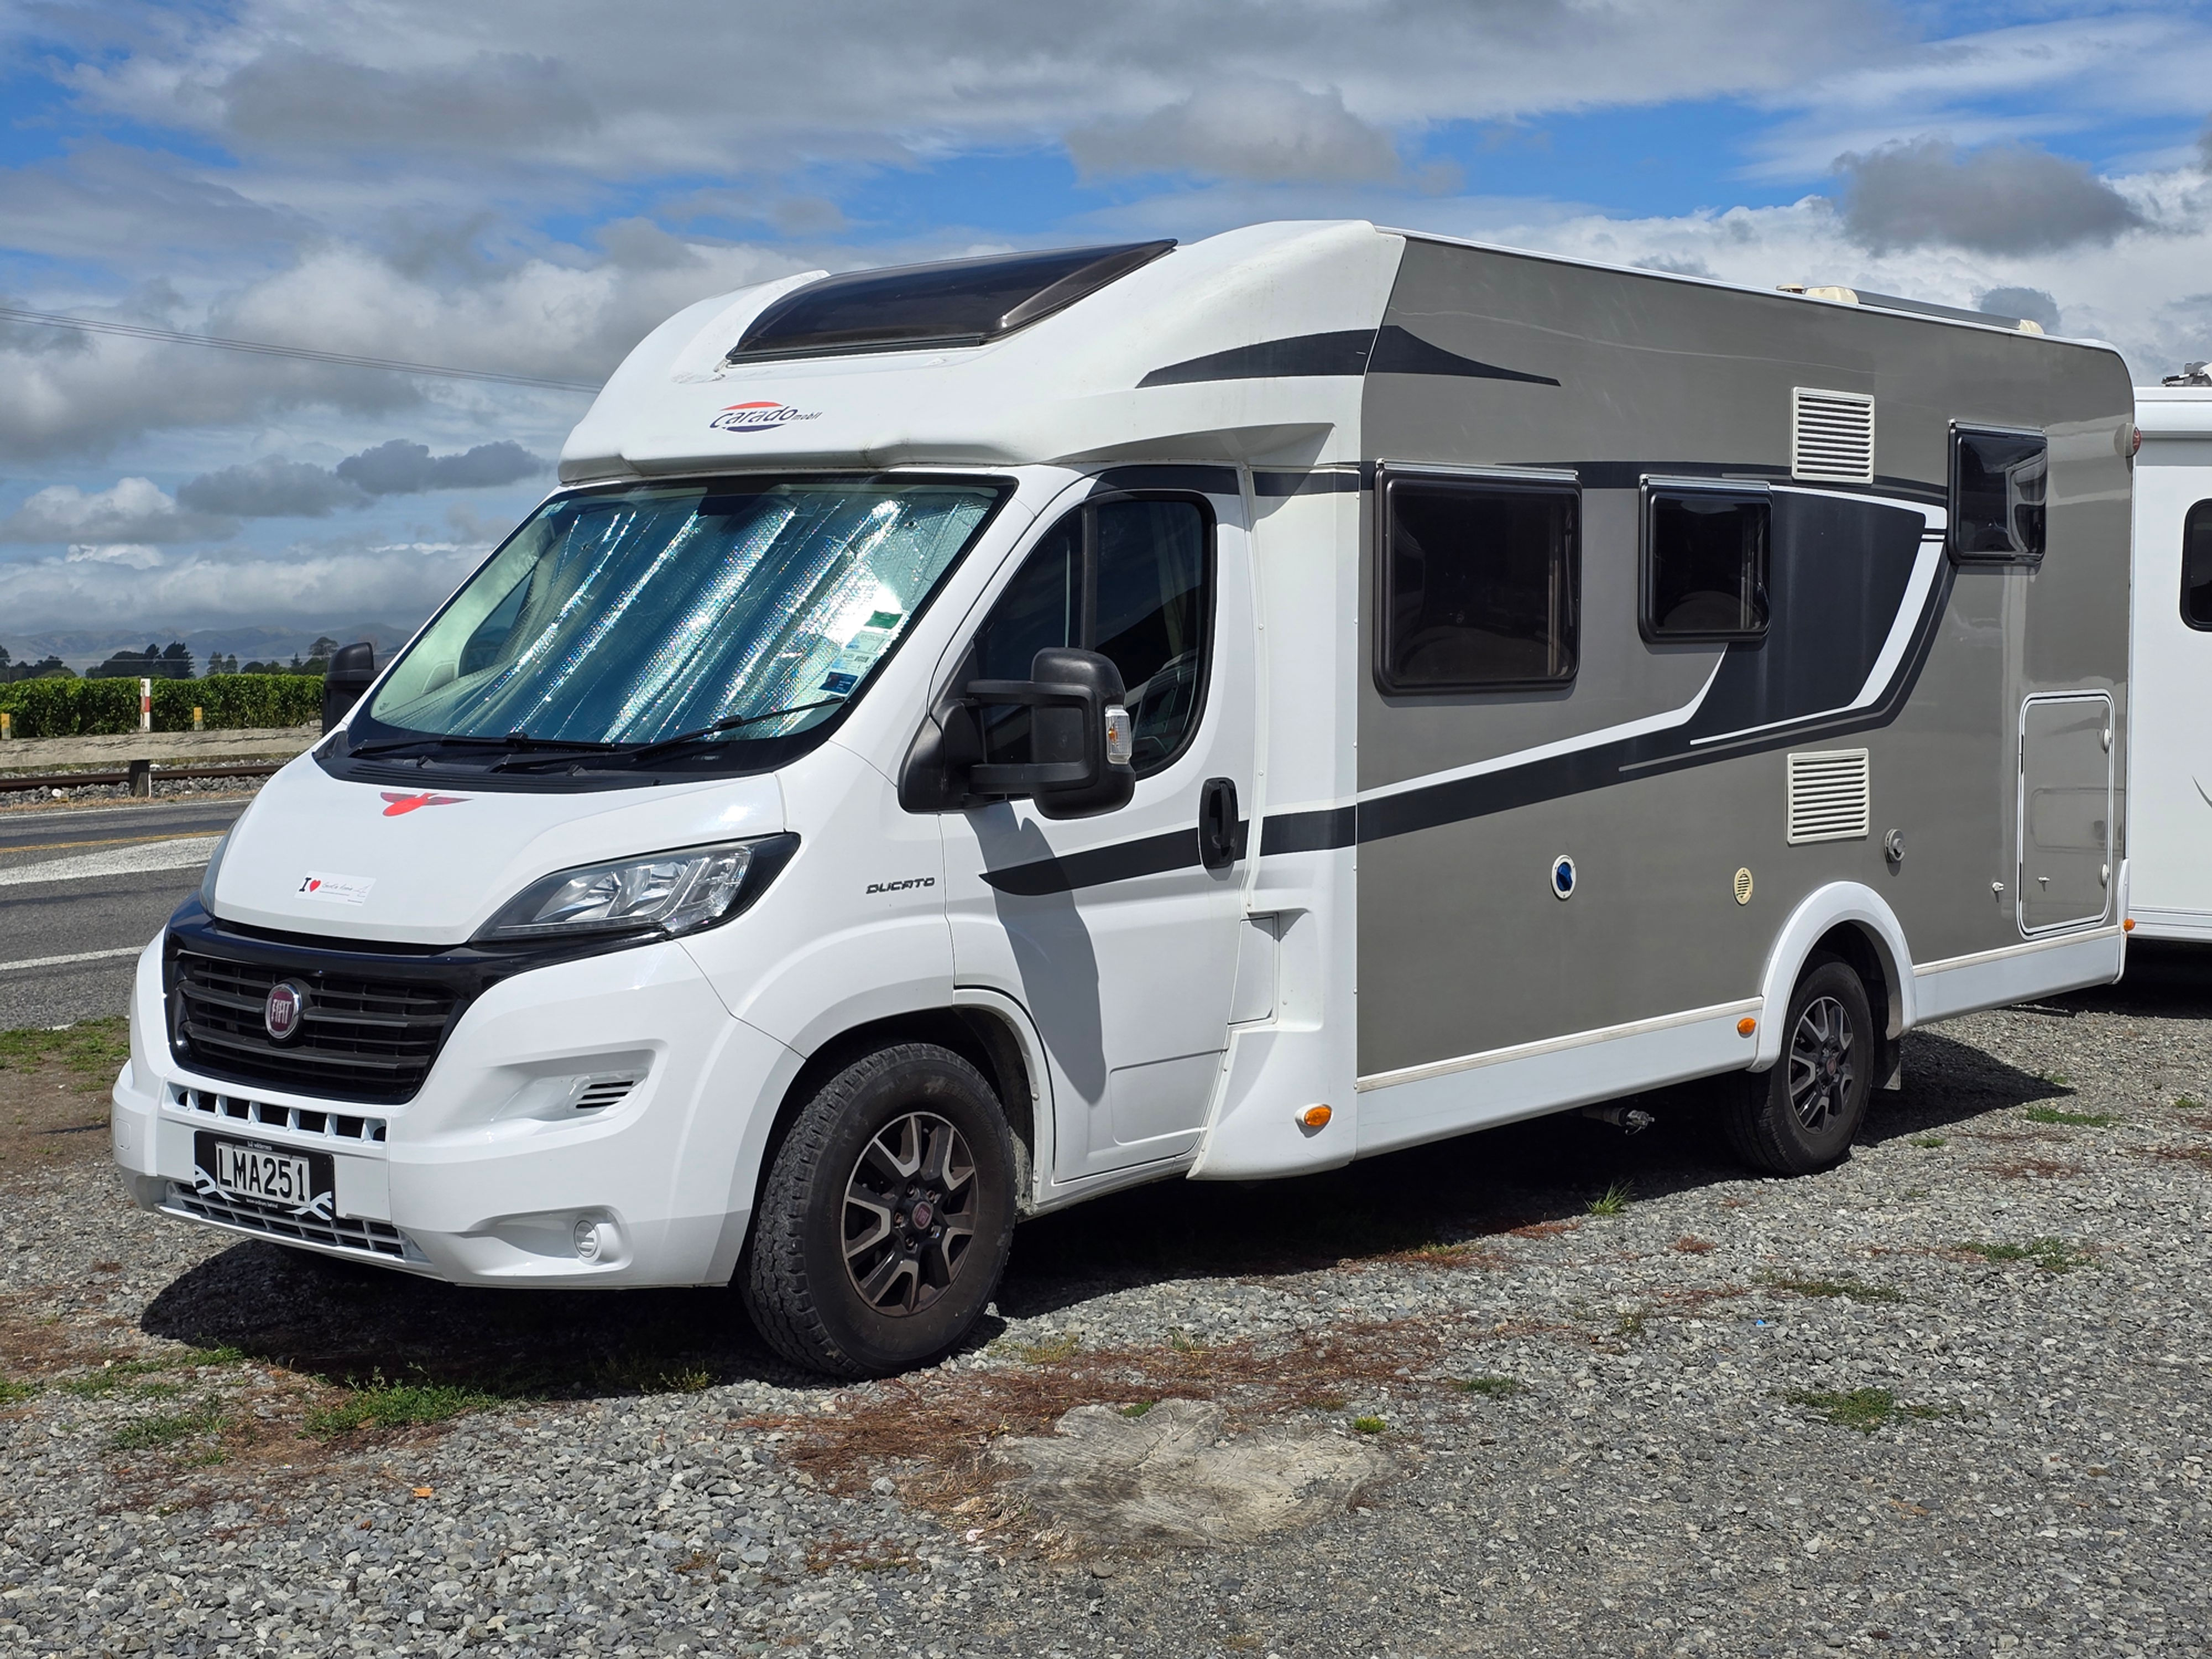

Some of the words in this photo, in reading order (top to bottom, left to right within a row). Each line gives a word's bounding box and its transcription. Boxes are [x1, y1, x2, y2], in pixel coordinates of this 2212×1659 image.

[299, 877, 311, 892] I
[866, 877, 935, 894] DUCATO
[271, 999, 291, 1024] FIAT
[218, 1148, 305, 1202] LMA251
